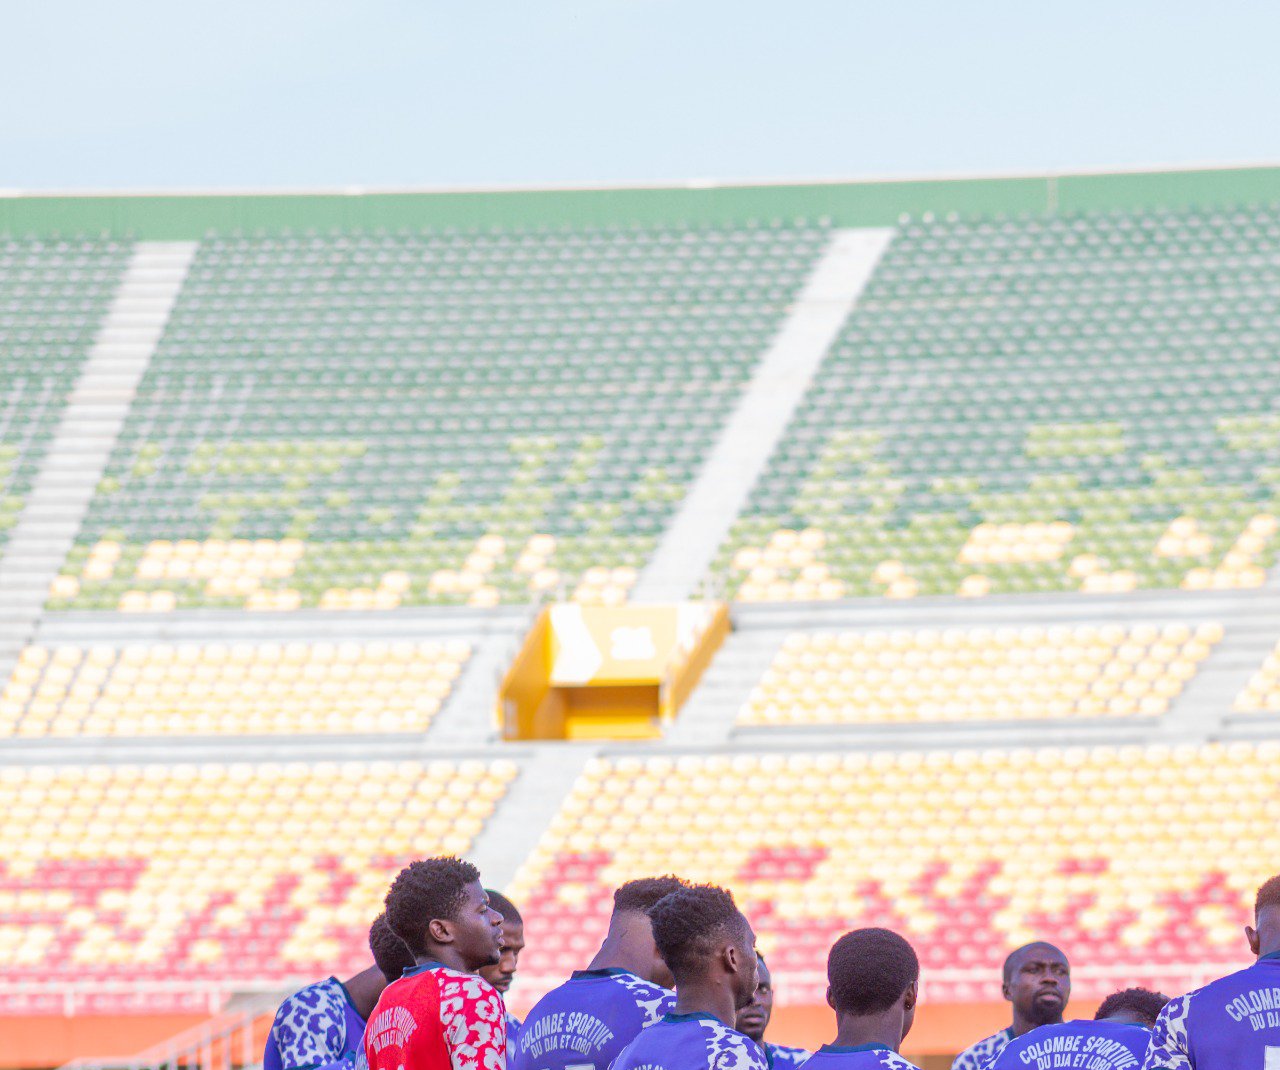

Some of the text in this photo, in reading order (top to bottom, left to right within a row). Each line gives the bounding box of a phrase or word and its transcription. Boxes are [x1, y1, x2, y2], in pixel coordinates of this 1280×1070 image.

[520, 1012, 614, 1054] COLOMBE SPORTIVE
[1249, 1012, 1265, 1031] DU
[530, 1034, 592, 1059] DU DJA ET LOBO
[1019, 1036, 1084, 1065] COLOMBE
[1054, 1053, 1071, 1068] DJA
[1072, 1053, 1087, 1068] ET
